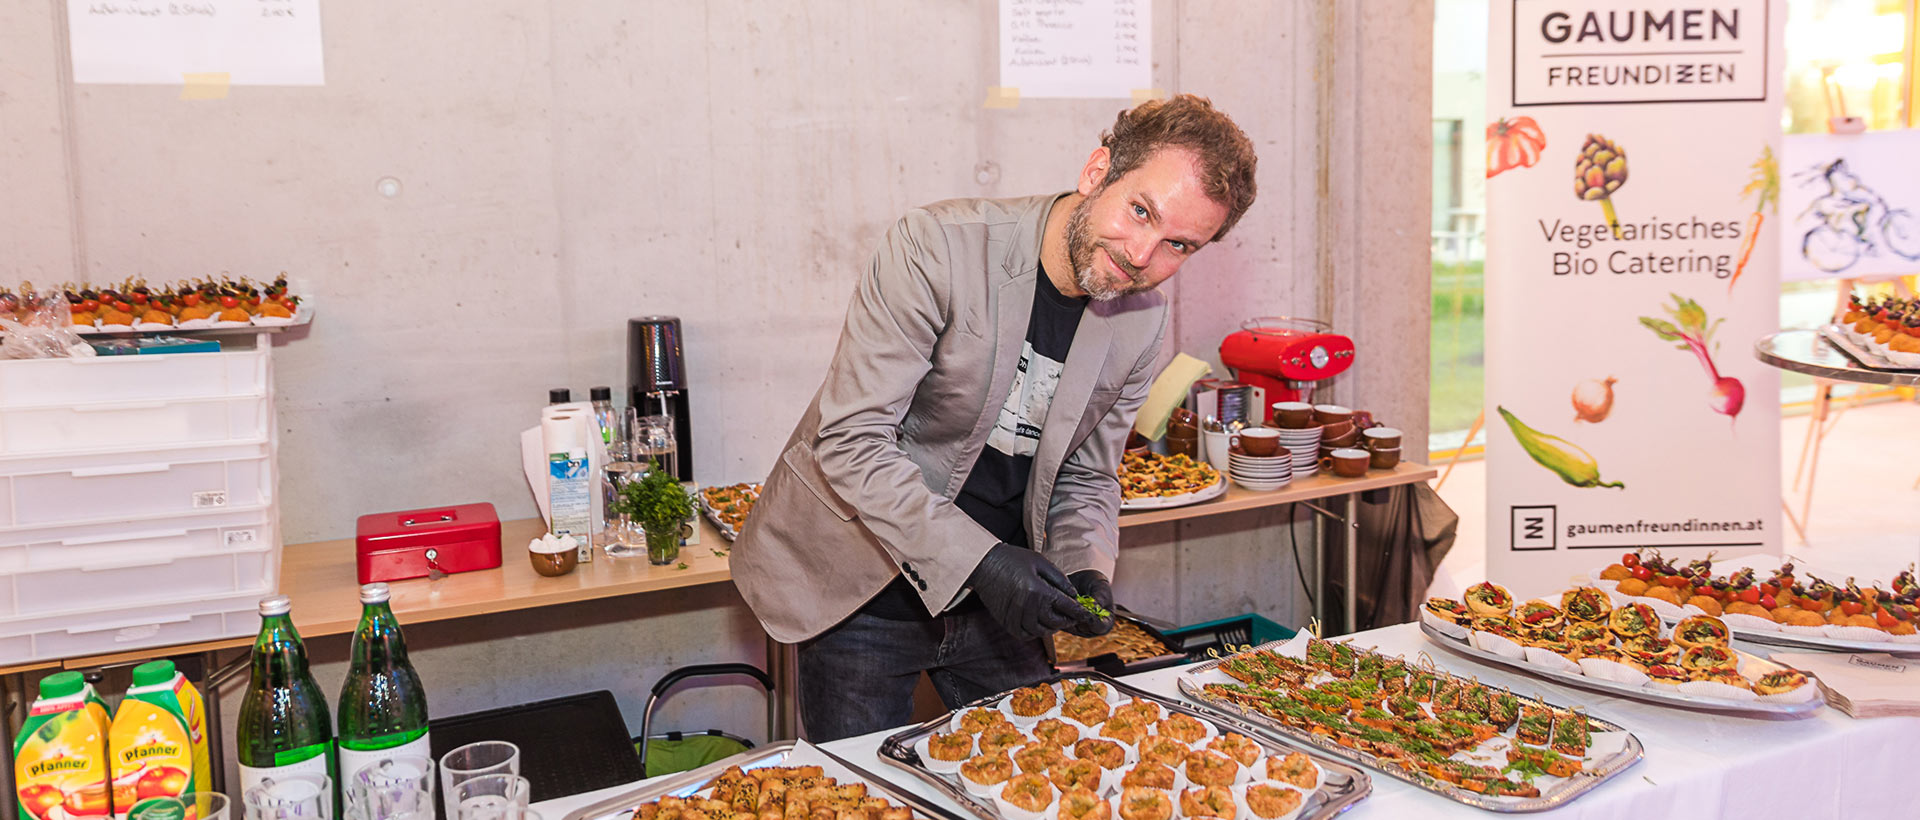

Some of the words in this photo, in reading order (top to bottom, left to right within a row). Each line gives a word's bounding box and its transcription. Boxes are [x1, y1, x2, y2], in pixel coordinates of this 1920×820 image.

[1541, 8, 1739, 43] GAUMEN
[1538, 215, 1741, 249] Vegetarisches
[1553, 251, 1598, 276] Bio
[1608, 249, 1731, 279] Catering
[1567, 518, 1764, 538] gaumenfreundinnen.at
